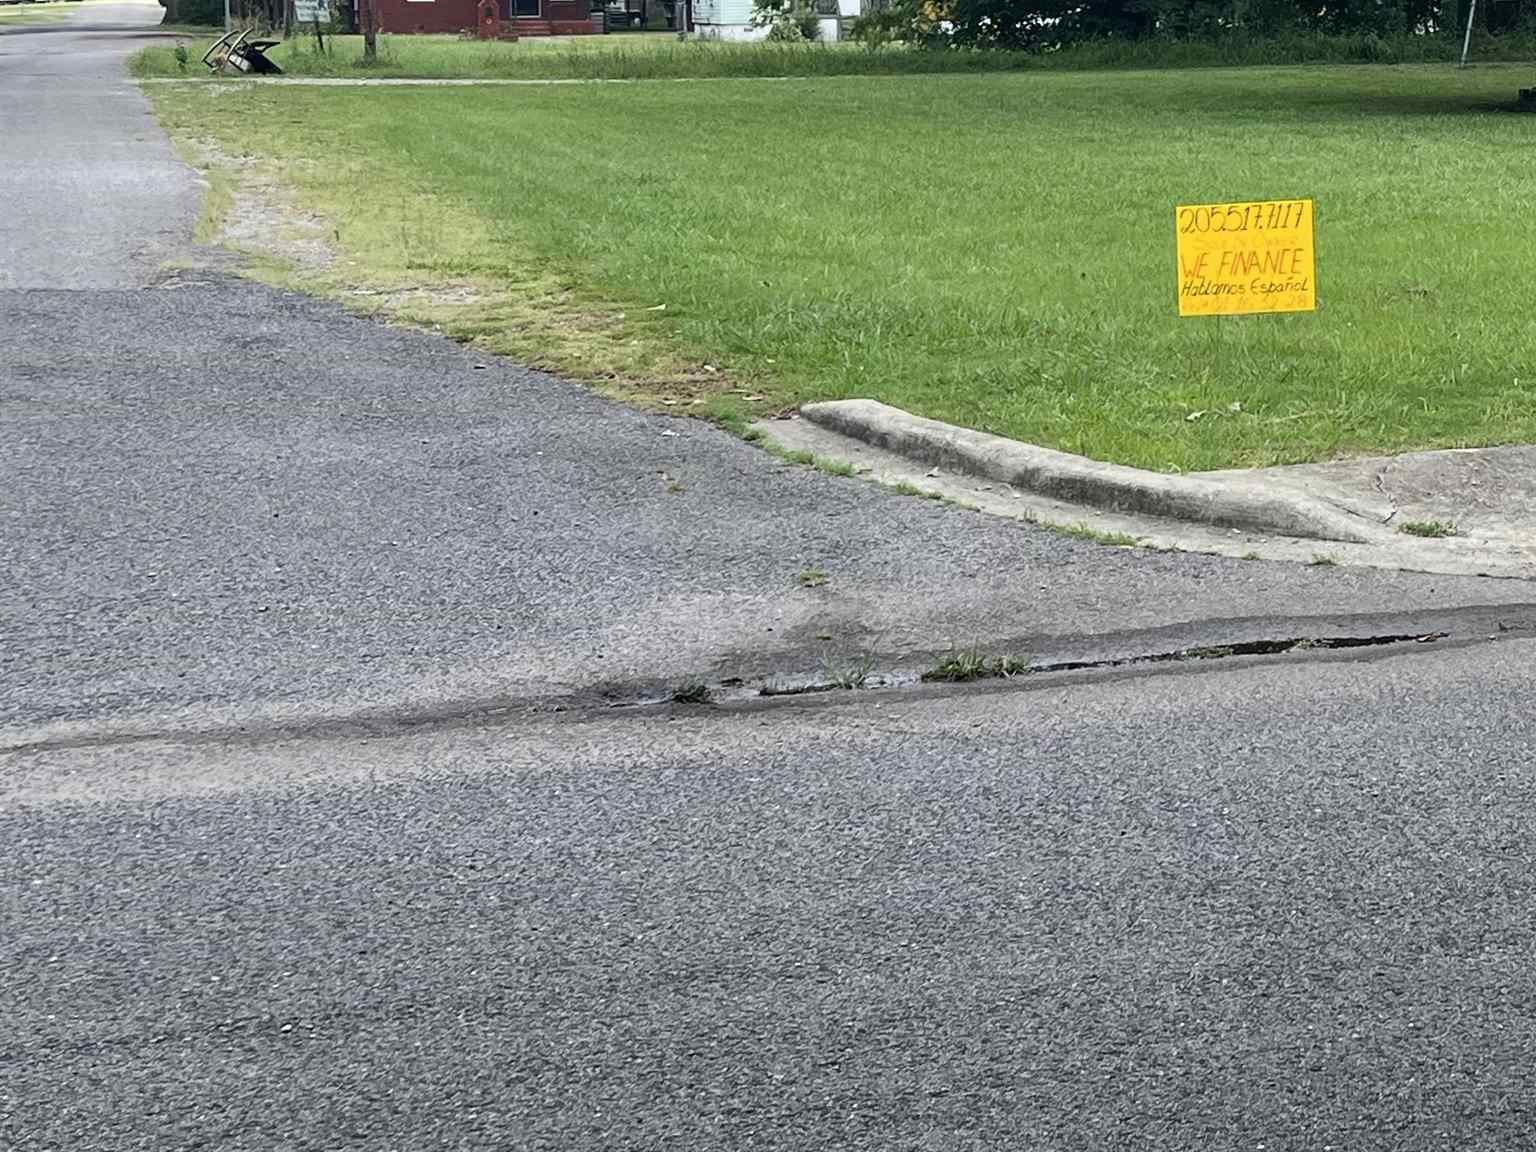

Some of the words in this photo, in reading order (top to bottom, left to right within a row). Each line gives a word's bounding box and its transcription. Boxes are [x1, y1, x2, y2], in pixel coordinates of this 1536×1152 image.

[1180, 250, 1210, 279] WE
[1218, 248, 1305, 278] FINANCE
[1181, 278, 1246, 296] Hablamos
[1251, 276, 1309, 295] Español
